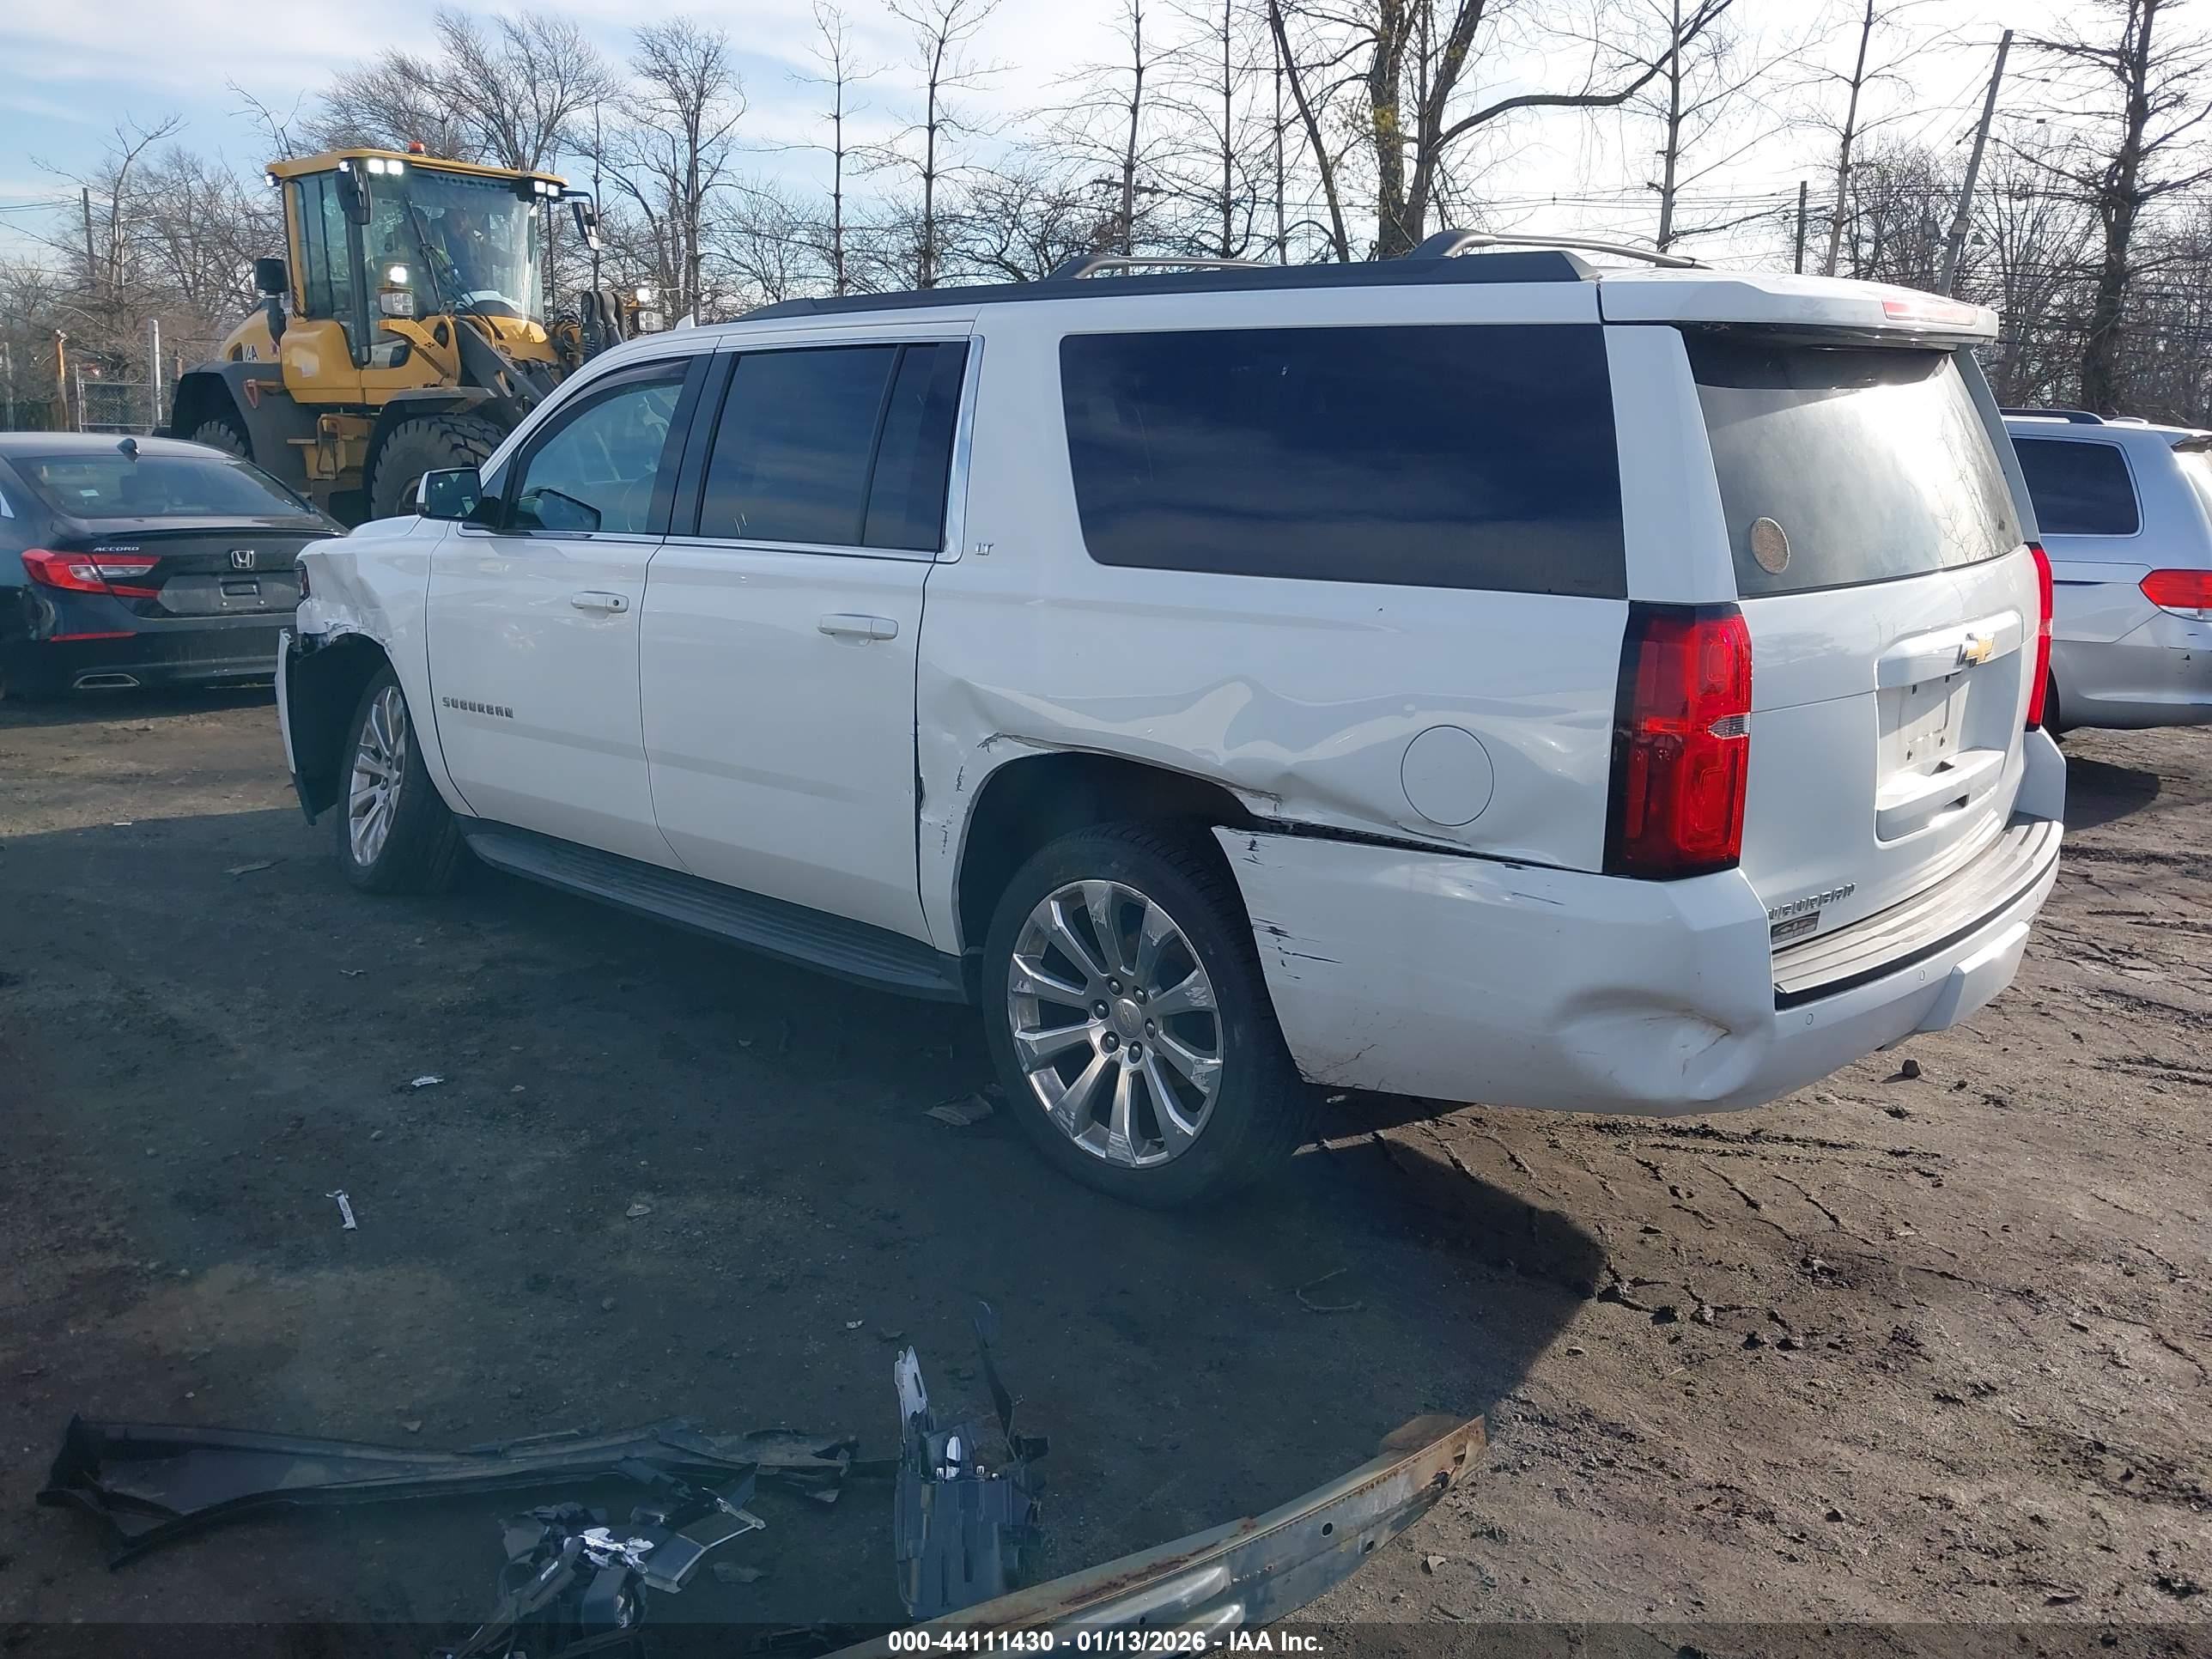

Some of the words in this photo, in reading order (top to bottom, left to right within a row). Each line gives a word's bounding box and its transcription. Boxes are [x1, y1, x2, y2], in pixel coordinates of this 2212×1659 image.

[975, 542, 994, 556] LT
[442, 696, 514, 719] SUBURBAN
[1768, 883, 1856, 921] UBURBAN
